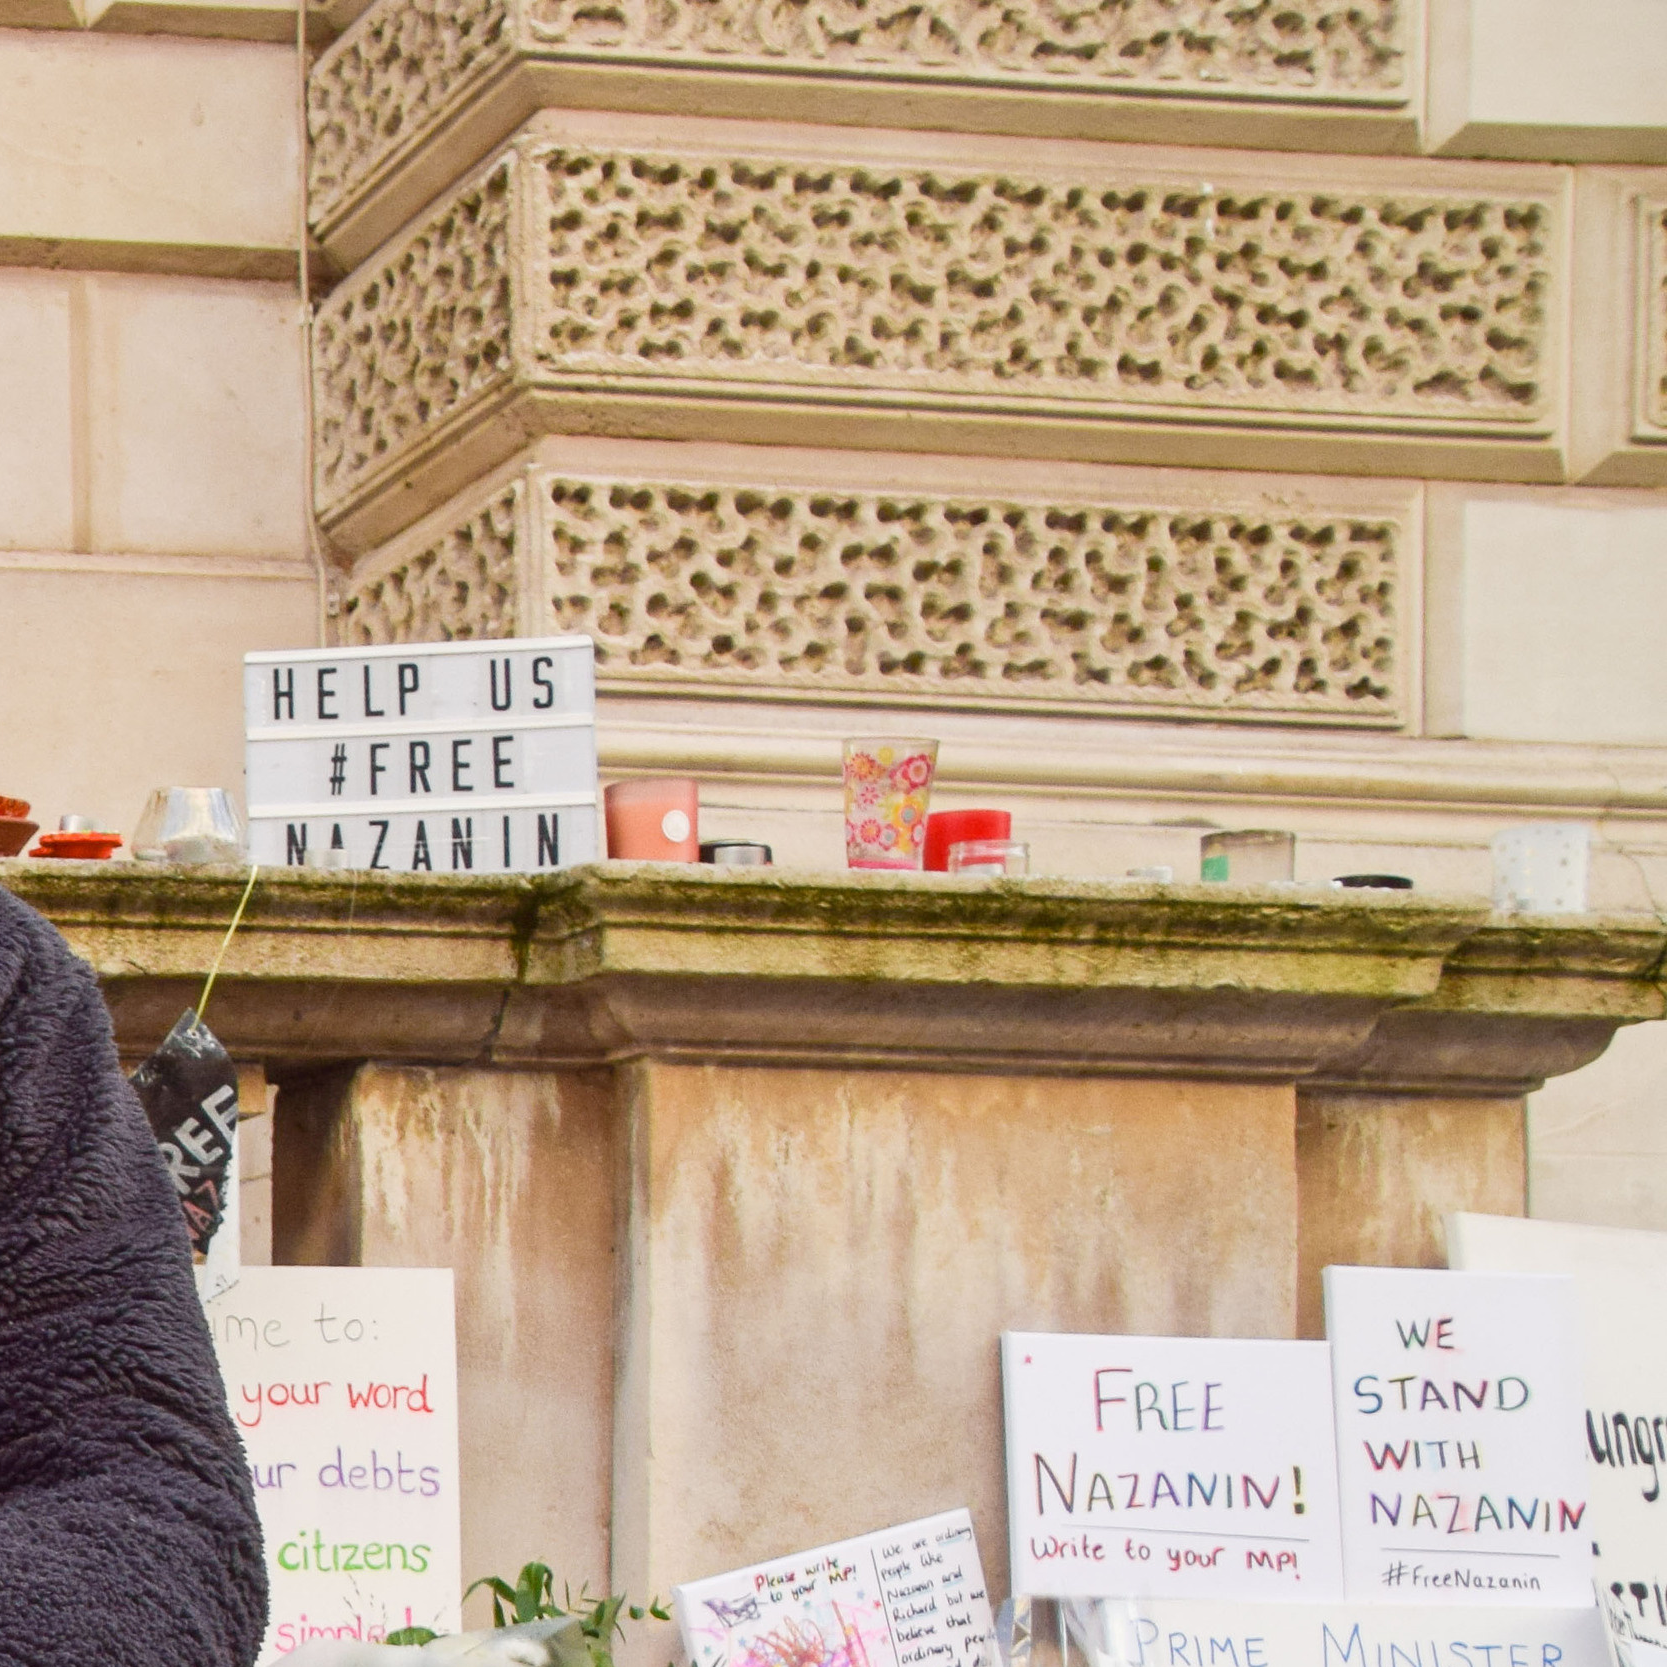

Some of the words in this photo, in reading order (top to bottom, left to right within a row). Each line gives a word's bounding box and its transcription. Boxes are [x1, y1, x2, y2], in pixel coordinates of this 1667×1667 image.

[273, 662, 420, 720] HELP
[490, 657, 554, 711] US
[330, 735, 515, 796] #FREE
[286, 812, 559, 872] NAZANIN
[314, 1303, 379, 1345] to:
[1396, 1317, 1456, 1350] WE
[236, 1381, 332, 1427] your
[347, 1373, 434, 1413] word
[1093, 1367, 1225, 1432] FREE
[1353, 1375, 1530, 1414] STAND
[253, 1463, 298, 1489] ur
[318, 1446, 441, 1497] debts
[1364, 1440, 1481, 1471] WITH
[1034, 1451, 1304, 1516] NAZANIN!
[1370, 1494, 1586, 1534] NAZANIN
[277, 1529, 432, 1573] citizens
[883, 1544, 902, 1559] We
[912, 1540, 928, 1551] are
[921, 1551, 944, 1567] like
[1031, 1534, 1106, 1561] Write
[1125, 1538, 1151, 1560] to
[1167, 1546, 1226, 1571] your
[1246, 1551, 1301, 1581] MP!
[754, 1572, 795, 1592] Please
[805, 1555, 840, 1576] write
[770, 1590, 783, 1603] to
[791, 1578, 816, 1601] your
[828, 1565, 857, 1585] MP!
[886, 1580, 934, 1601] Nazanin
[942, 1565, 964, 1585] and
[1381, 1561, 1541, 1591] #FreeNazanin
[892, 1602, 937, 1622] Richard
[948, 1589, 963, 1606] but
[970, 1590, 986, 1601] we
[896, 1625, 937, 1643] believe
[945, 1613, 972, 1629] that
[901, 1645, 954, 1665] ordinary
